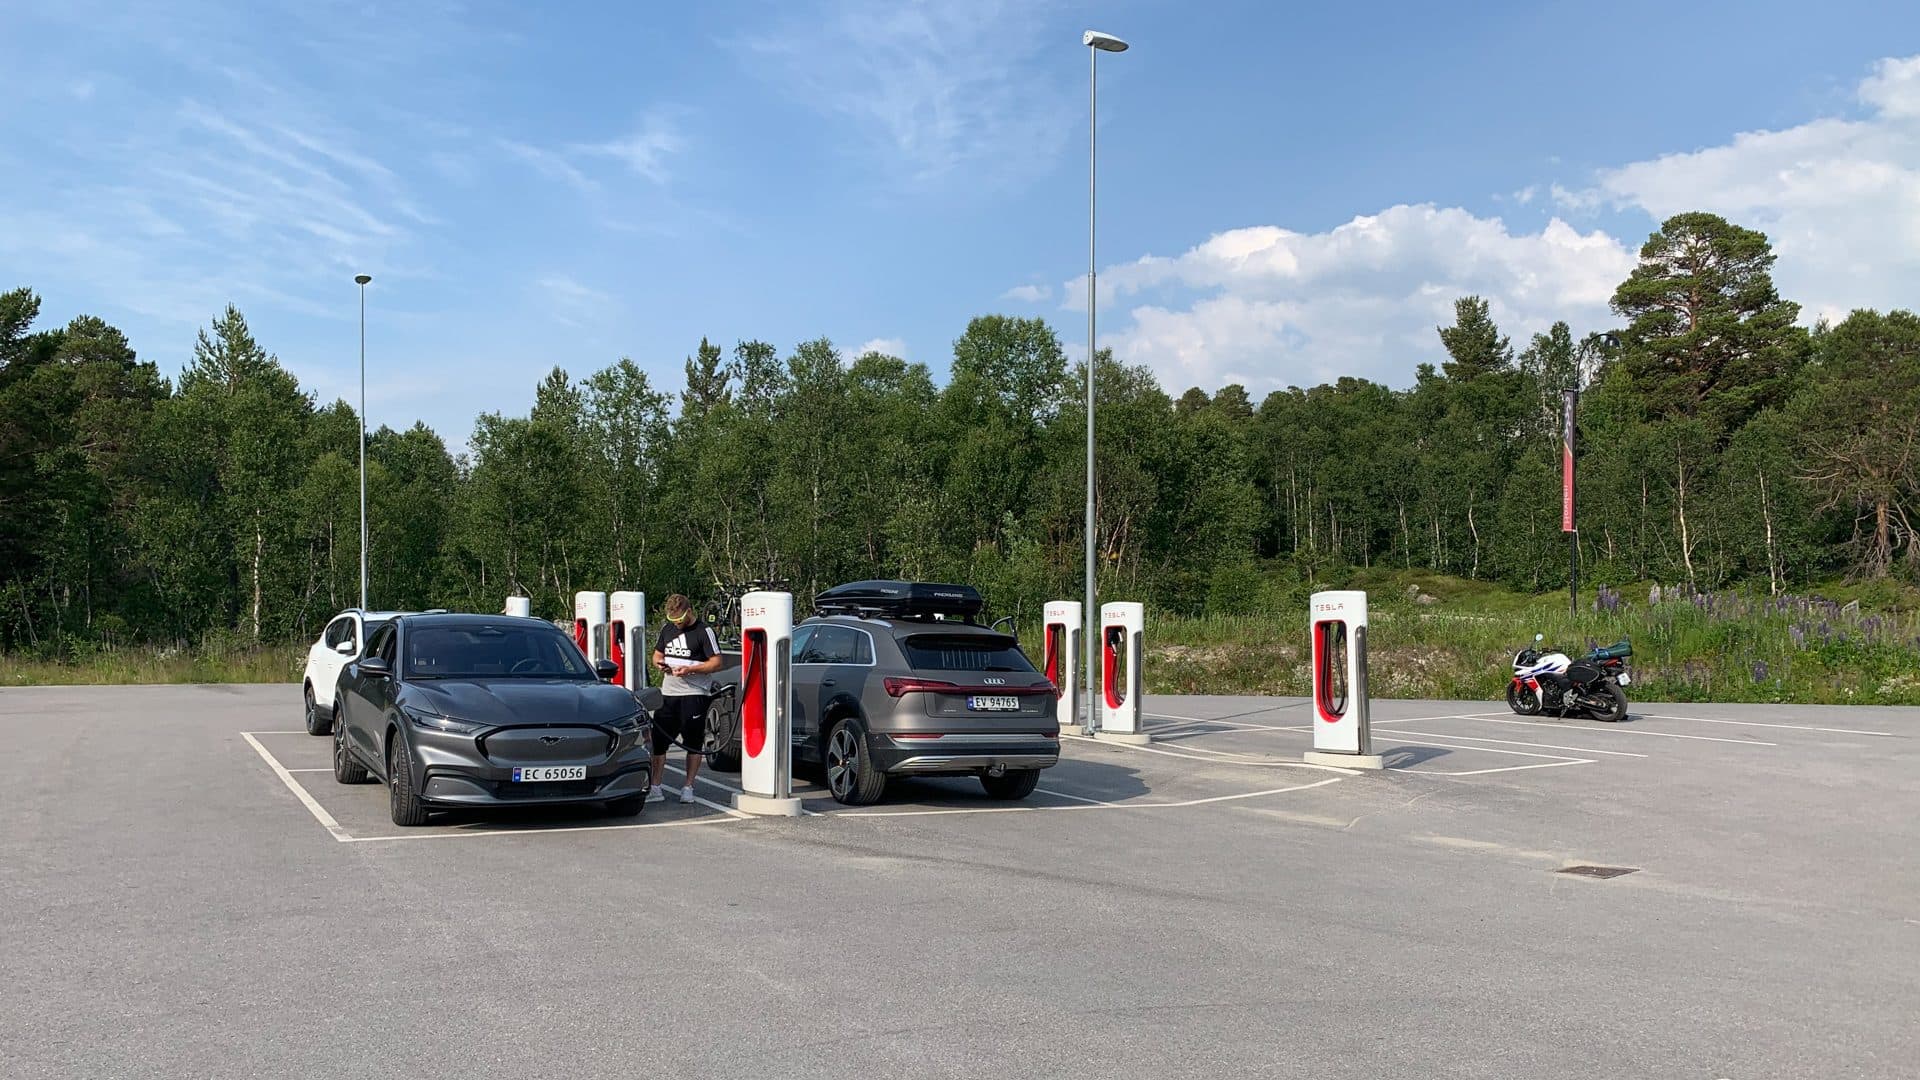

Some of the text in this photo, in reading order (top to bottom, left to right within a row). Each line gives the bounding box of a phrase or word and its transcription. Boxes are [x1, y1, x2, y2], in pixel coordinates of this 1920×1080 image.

[743, 607, 766, 617] TESLA
[1315, 603, 1344, 612] TESLA
[976, 697, 1017, 708] EV 94765
[524, 767, 583, 780] EC 65056
